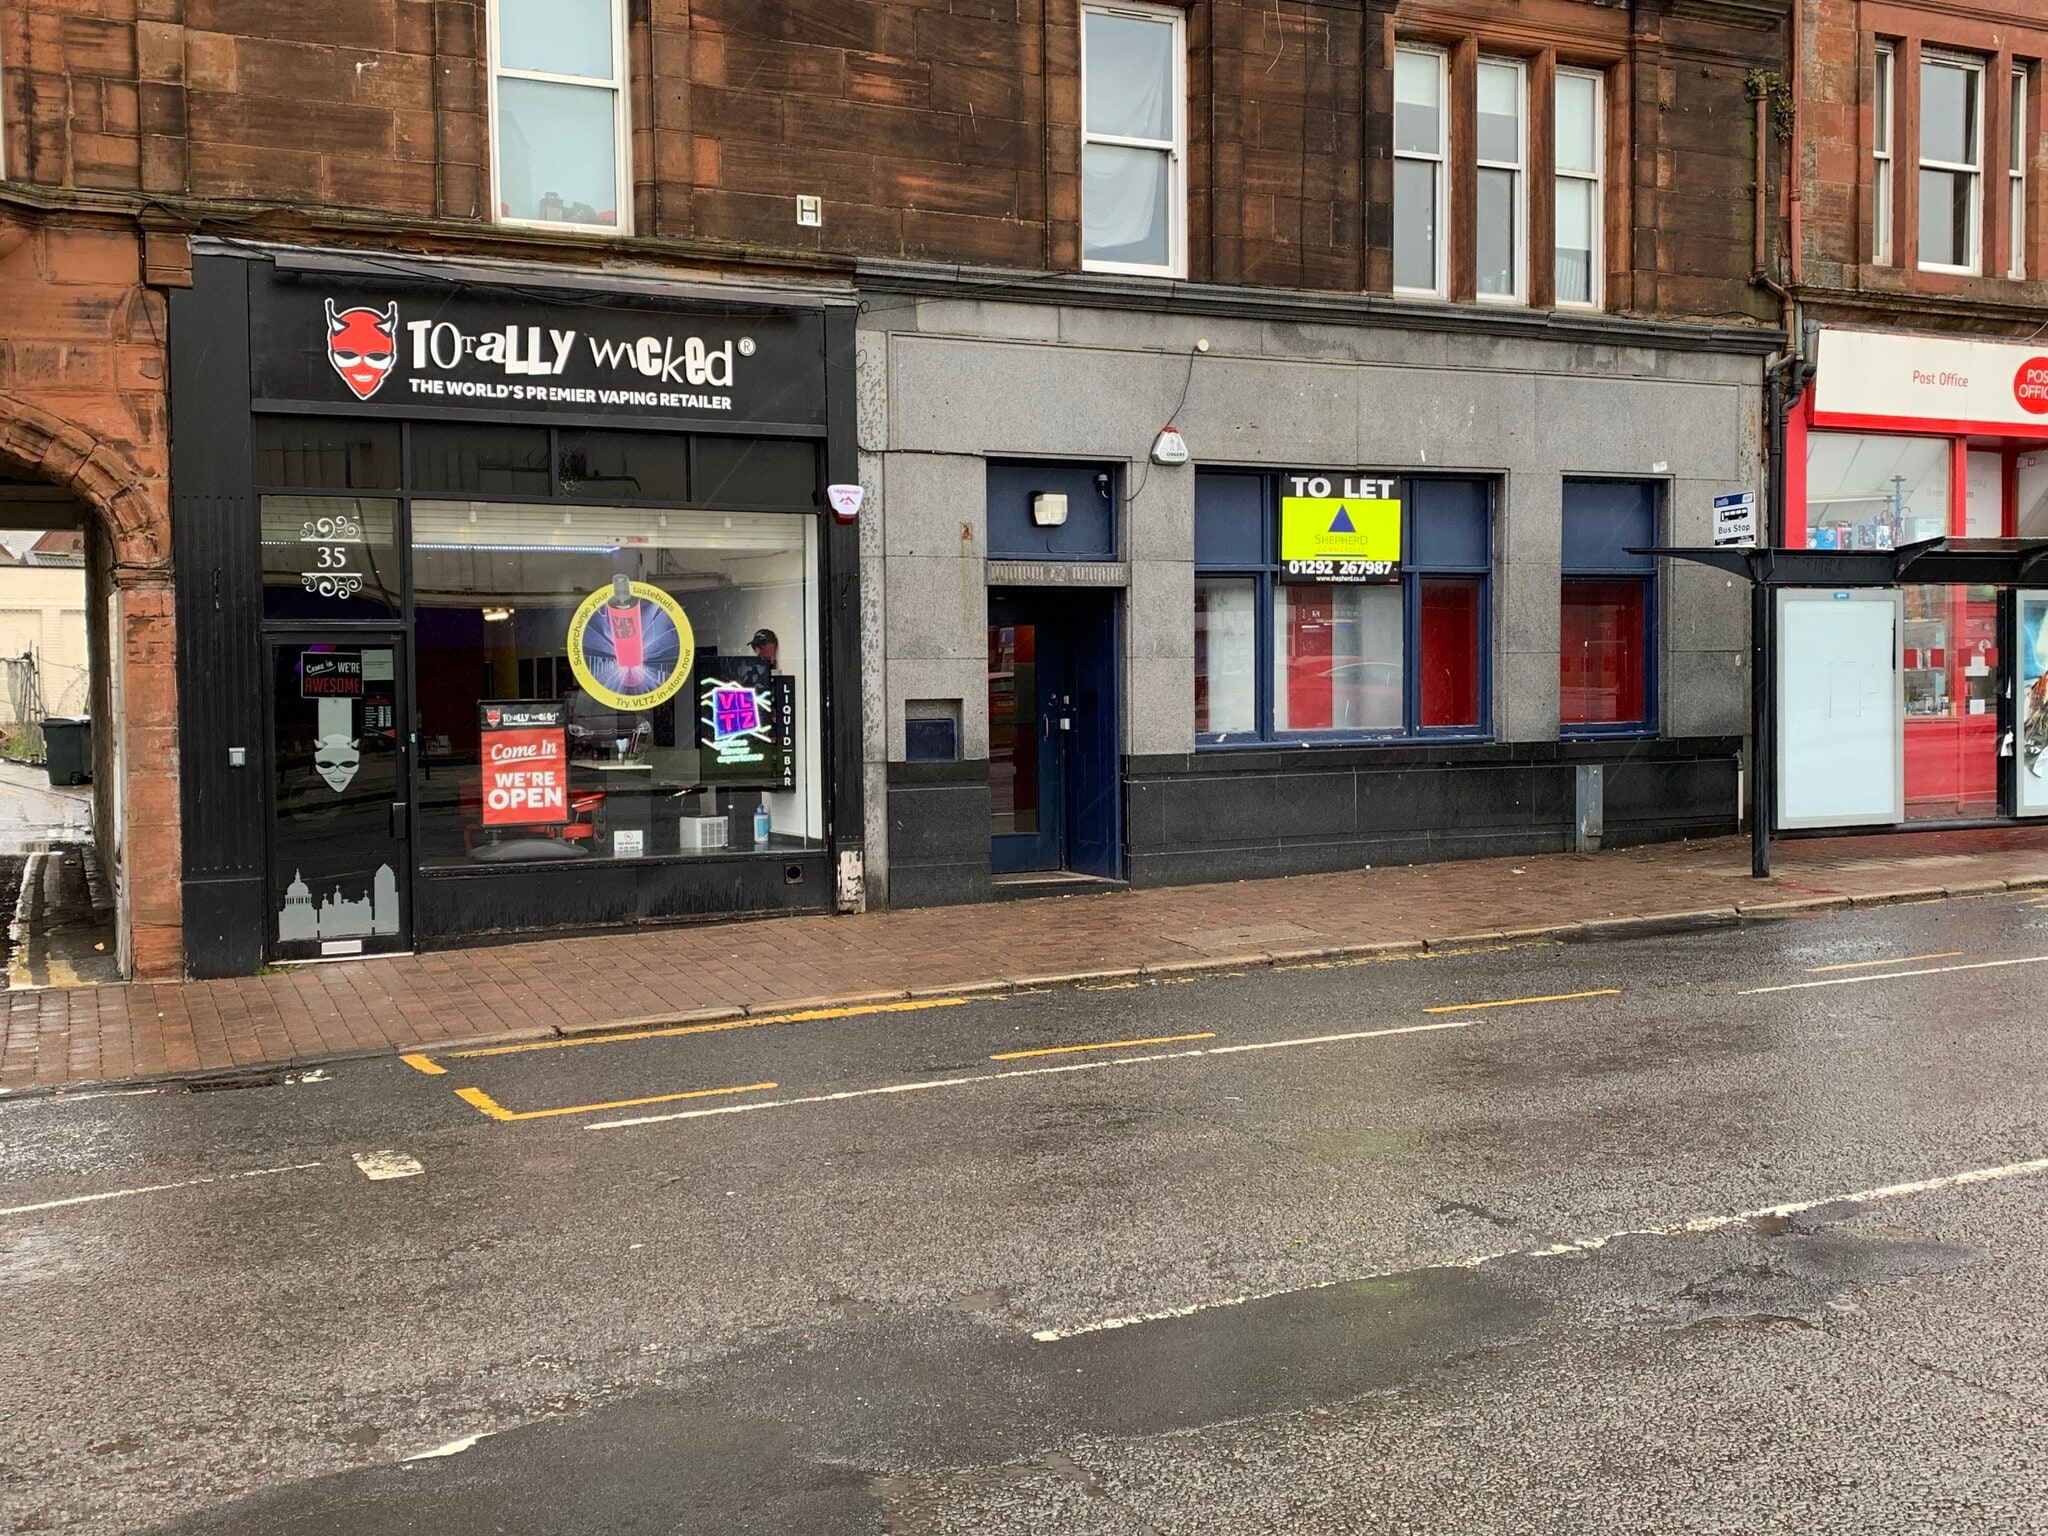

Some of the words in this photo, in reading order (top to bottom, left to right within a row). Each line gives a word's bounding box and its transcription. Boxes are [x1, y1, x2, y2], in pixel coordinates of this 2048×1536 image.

[800, 199, 818, 223] H
[1912, 369, 1936, 385] Post
[1939, 371, 1969, 388] Office
[408, 378, 444, 395] THE
[446, 381, 525, 400] WORLD'S
[526, 385, 597, 404] PREMIER
[598, 389, 658, 408] VAPING
[660, 392, 732, 411] RETAILER
[1290, 477, 1332, 498] TO
[1343, 478, 1395, 499] LET
[1314, 534, 1368, 545] SHEPHERD
[1718, 526, 1732, 534] Bus
[1733, 524, 1751, 532] Stop
[317, 546, 347, 568] 35
[1288, 560, 1334, 575] 01292
[1339, 560, 1393, 575] 267987
[572, 606, 592, 667] Supercharge
[589, 591, 609, 609] your
[632, 585, 675, 613] tastebuds
[306, 663, 326, 674] Come
[325, 659, 334, 668] in
[337, 662, 361, 673] WE'RE
[304, 677, 361, 694] AWESOME
[616, 697, 630, 708] Try
[632, 695, 657, 707] VLTZ
[657, 673, 686, 700] in-store
[682, 648, 691, 673] now
[783, 684, 792, 746] LIQUID
[491, 743, 537, 760] Come
[541, 739, 558, 755] In
[494, 771, 556, 788] WE'RE
[783, 756, 792, 787] BAR
[488, 787, 562, 810] OPEN
